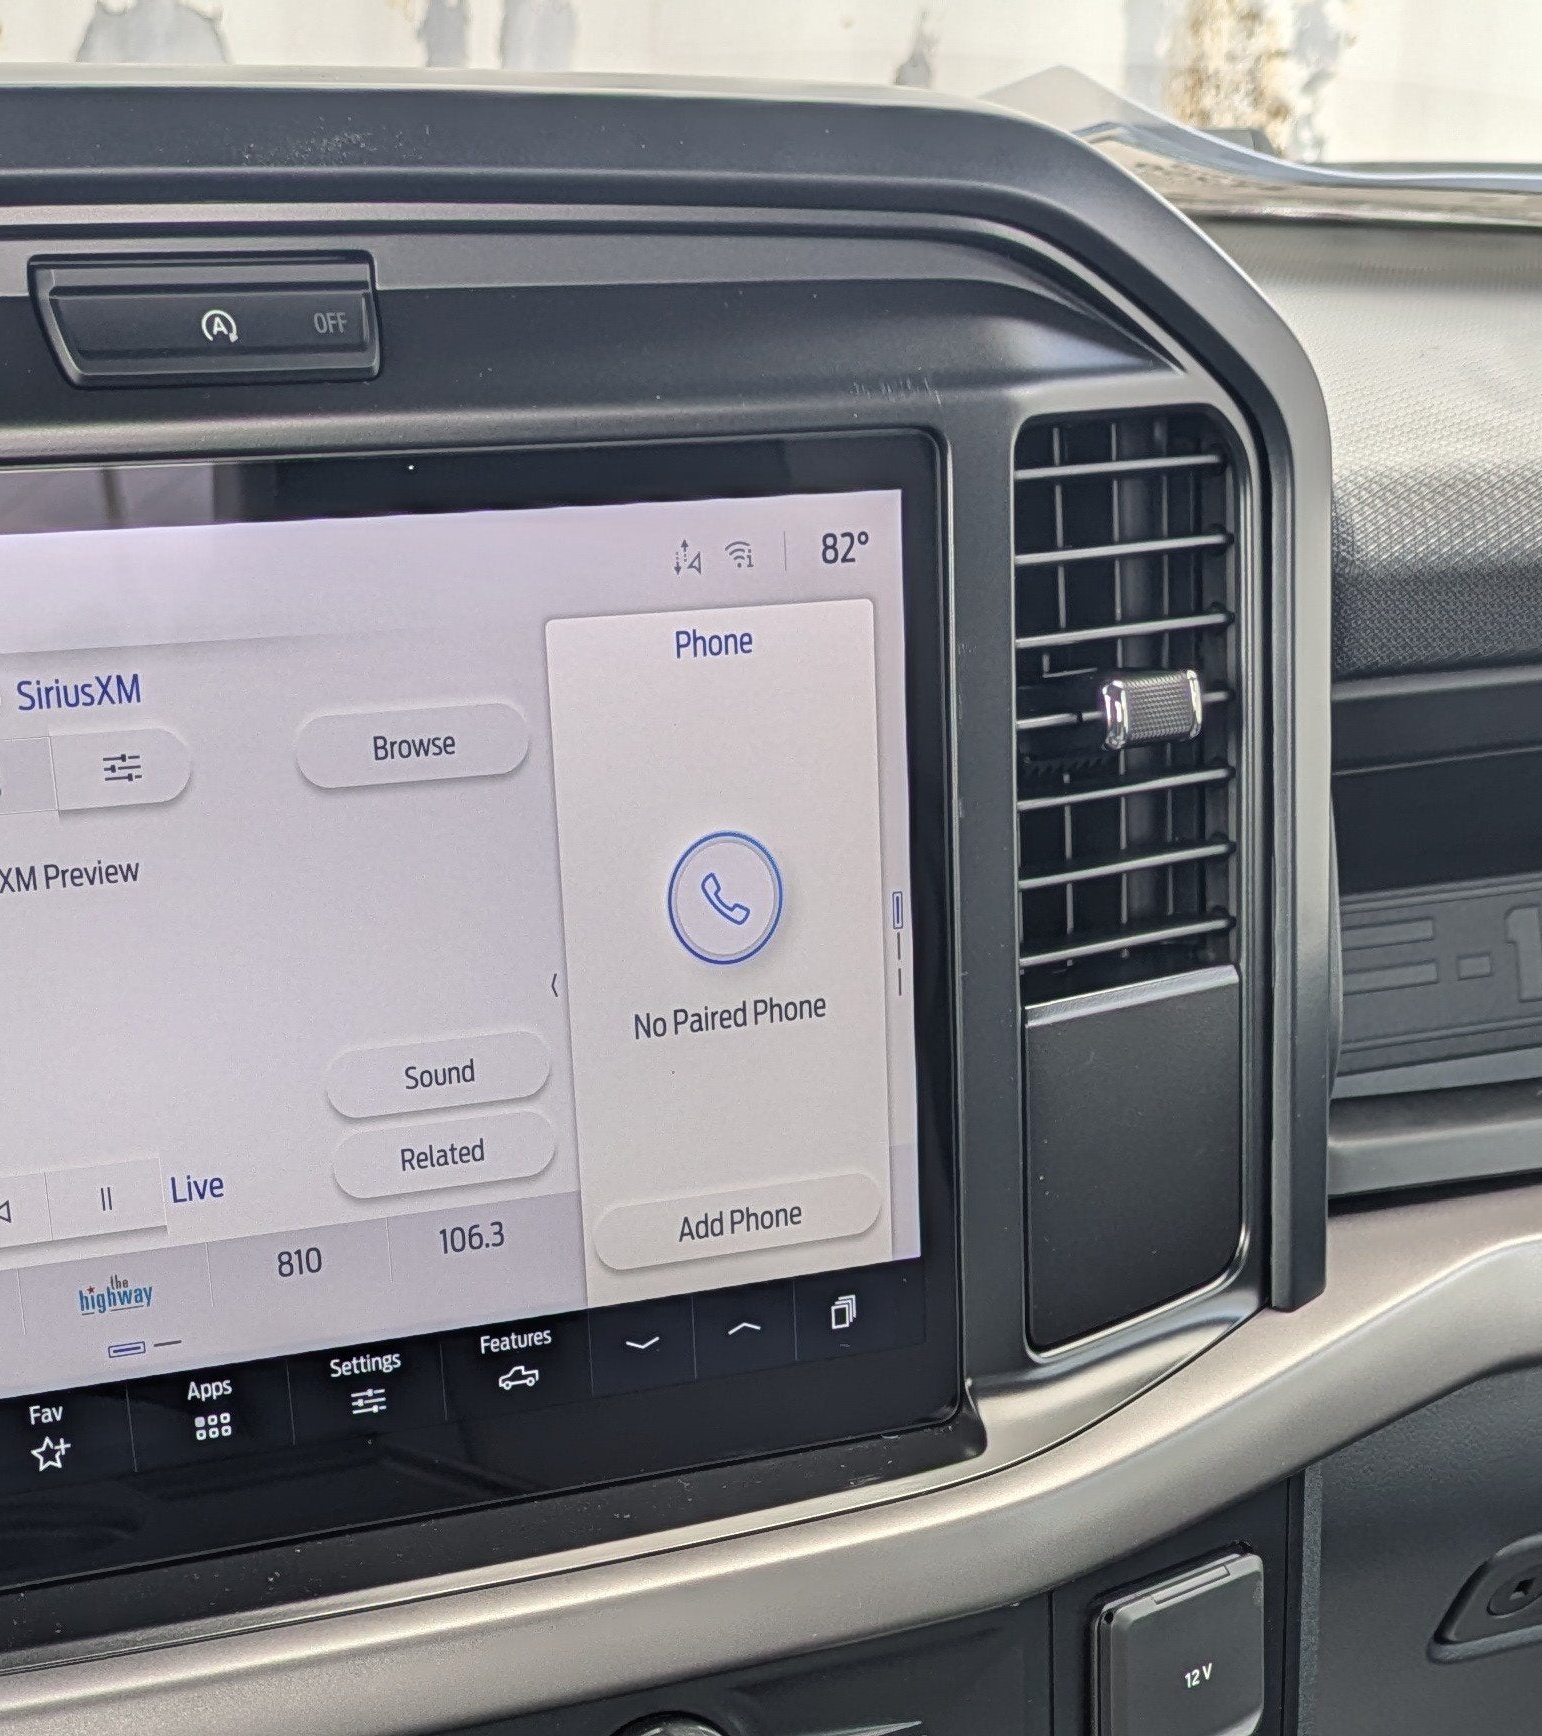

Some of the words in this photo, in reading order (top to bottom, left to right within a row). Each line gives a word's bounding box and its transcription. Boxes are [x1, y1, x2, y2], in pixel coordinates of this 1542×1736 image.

[313, 312, 347, 334] OFF
[675, 628, 753, 659] Phone
[16, 674, 141, 711] SiriusXM
[373, 733, 456, 761] Browse
[43, 860, 139, 890] Preview
[634, 1012, 668, 1040] No
[673, 1003, 748, 1035] Paired
[754, 996, 826, 1027] Phone
[404, 1058, 476, 1090] Sound
[400, 1138, 485, 1172] Related
[171, 1175, 224, 1204] Live
[678, 1214, 725, 1243] Add
[731, 1203, 802, 1236] Phone
[439, 1221, 505, 1255] 106.3
[277, 1246, 322, 1279] 810
[110, 1274, 129, 1290] the
[79, 1286, 153, 1313] highway
[480, 1327, 552, 1354] Features
[330, 1352, 401, 1379] Settings
[187, 1377, 233, 1403] Apps
[29, 1404, 63, 1426] Fav
